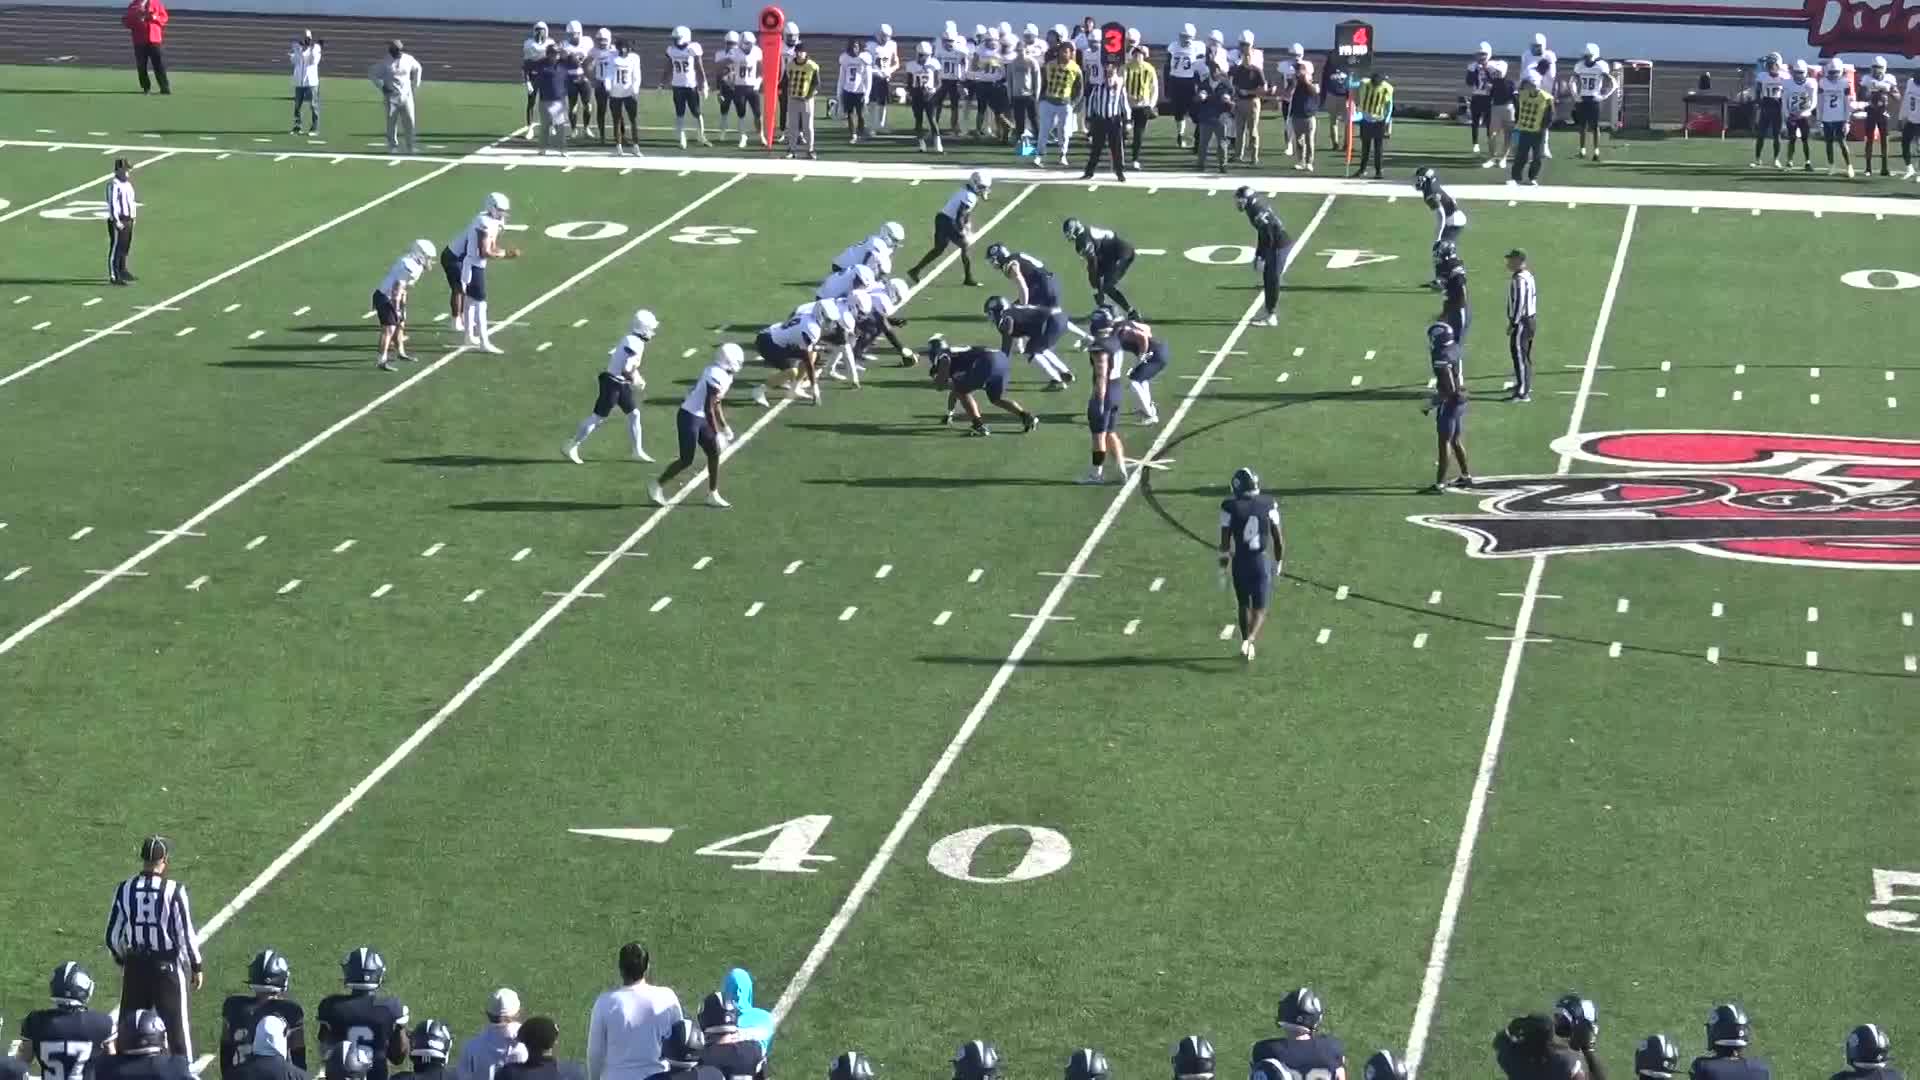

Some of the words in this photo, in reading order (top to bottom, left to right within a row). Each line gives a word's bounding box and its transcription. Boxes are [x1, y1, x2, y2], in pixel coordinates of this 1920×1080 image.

[1104, 31, 1123, 54] 3
[1353, 28, 1368, 44] 4
[1173, 56, 1191, 70] 73
[1829, 95, 1838, 108] 2
[1243, 515, 1260, 551] 4
[135, 891, 158, 923] H
[40, 1041, 93, 1080] 57
